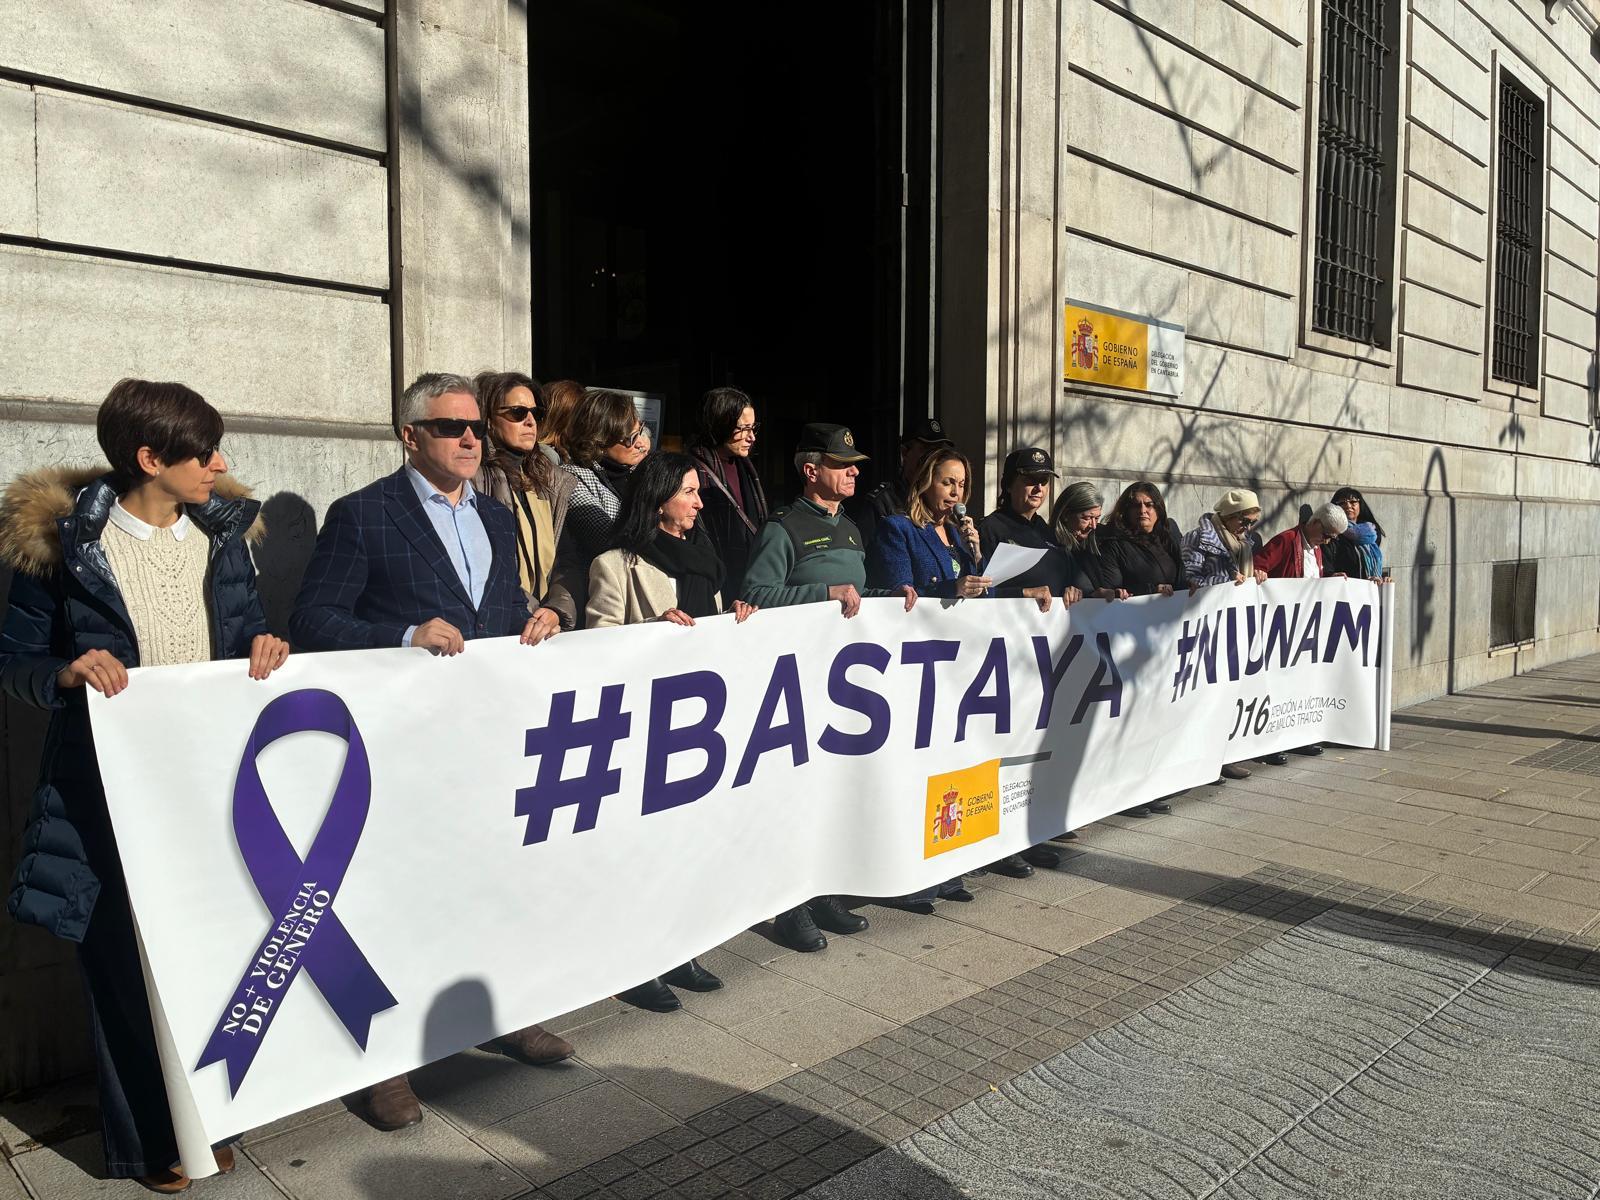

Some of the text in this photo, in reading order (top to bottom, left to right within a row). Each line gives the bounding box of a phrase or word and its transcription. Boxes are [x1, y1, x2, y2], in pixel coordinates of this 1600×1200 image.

[1104, 342, 1138, 356] GOBIERNO
[1103, 355, 1138, 369] DE ESPAÑA
[1159, 361, 1178, 370] GOBIERNO
[1157, 369, 1179, 378] CANTABRIA
[1304, 696, 1347, 711] VÍCTIMAS
[1266, 720, 1276, 733] DE
[1297, 710, 1323, 725] TRATOS
[514, 632, 1123, 846] #BASTAYA
[968, 791, 993, 806] GOBIERNO
[1011, 788, 1034, 800] GOBIERNO
[965, 801, 993, 818] DE ESPAÑA
[222, 881, 318, 1037] NO + VIOLENCIA
[240, 889, 331, 1037] DE GENERO
